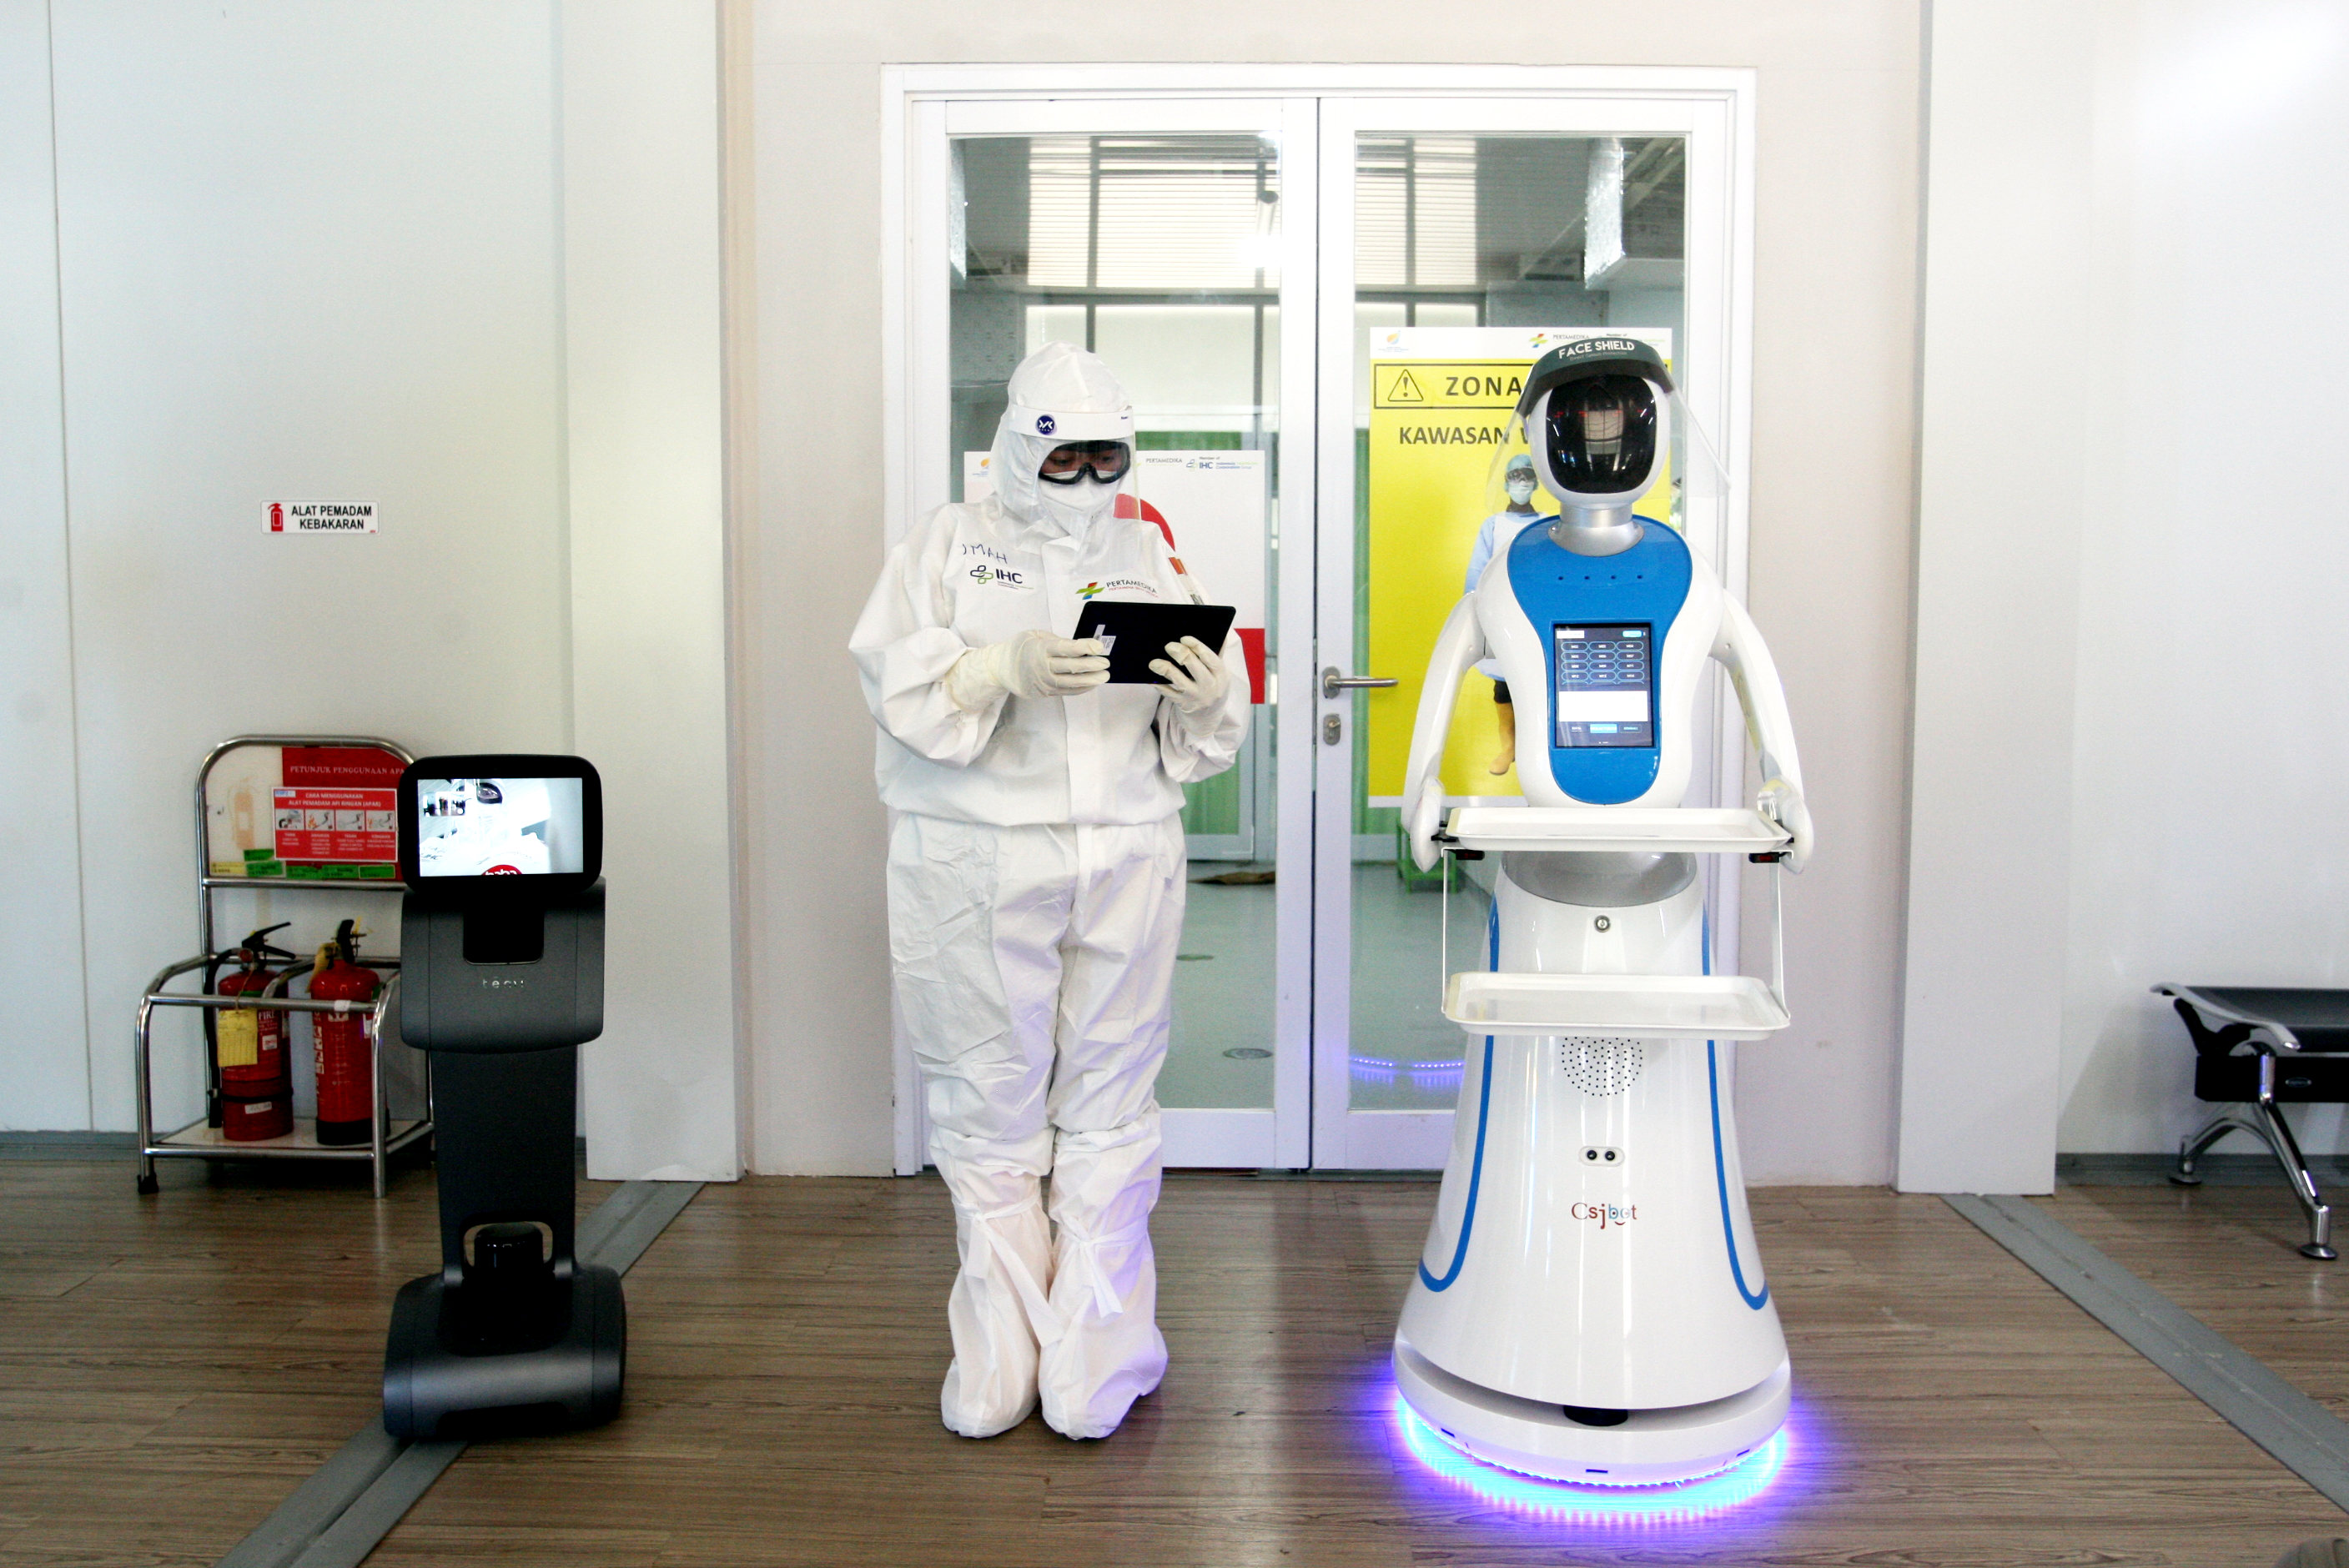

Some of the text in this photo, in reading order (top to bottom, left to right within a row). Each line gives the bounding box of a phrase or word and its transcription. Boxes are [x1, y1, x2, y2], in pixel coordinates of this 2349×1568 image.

[1558, 341, 1592, 359] FACE
[1595, 340, 1635, 351] SHIELD
[1446, 377, 1522, 396] ZONA
[1399, 426, 1510, 445] KAWASAN
[292, 505, 372, 516] ALAT PEMADAM
[299, 519, 365, 530] KEBAKARAN
[995, 568, 1023, 584] IHC
[290, 765, 331, 773] PETUNJUK
[1571, 1202, 1637, 1229] Csjbot
